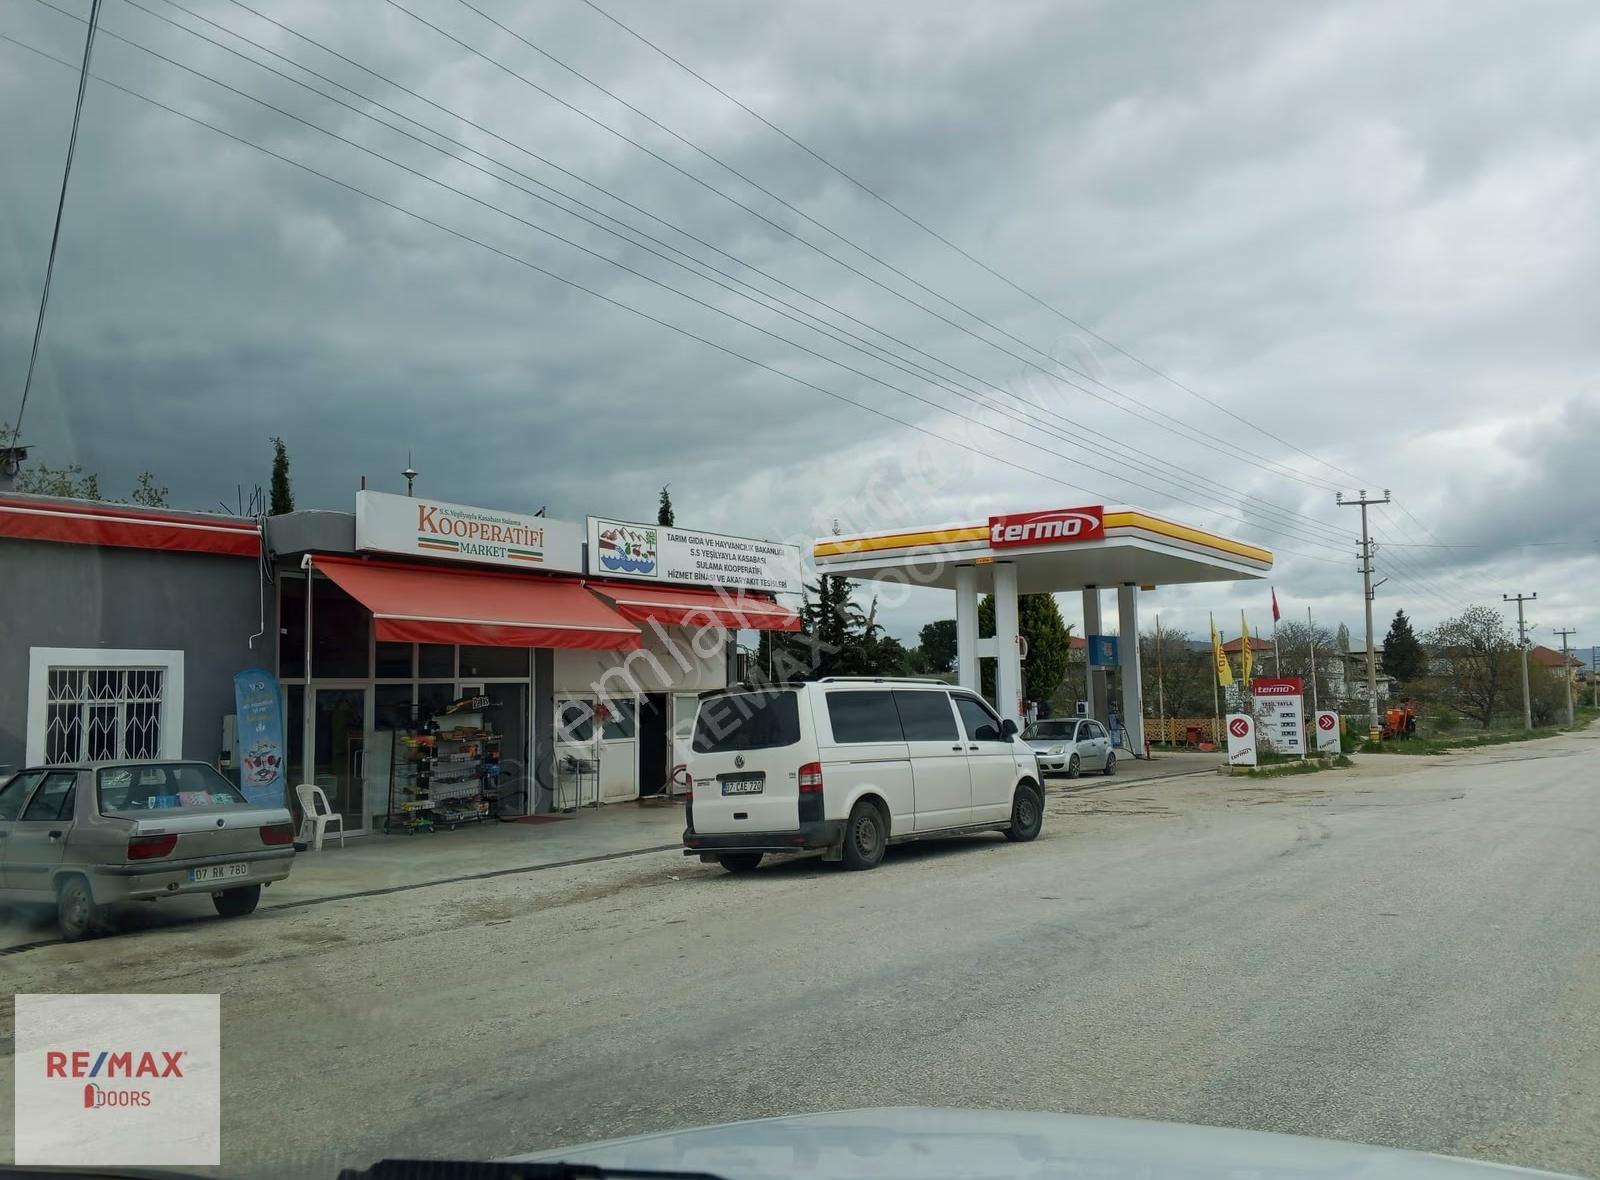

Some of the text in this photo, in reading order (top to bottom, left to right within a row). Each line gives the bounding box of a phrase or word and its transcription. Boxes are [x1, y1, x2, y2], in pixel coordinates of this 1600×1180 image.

[418, 504, 545, 548] KOOPERATİFİ
[991, 518, 1082, 543] termo
[667, 533, 688, 543] TARIM
[688, 535, 704, 546] GIDA
[705, 537, 714, 547] VE
[715, 538, 754, 552] HAYVANCILIK
[460, 542, 508, 558] MARKET
[696, 561, 723, 571] SULAMA
[667, 569, 693, 579] HİZMET
[716, 574, 726, 583] VE
[1257, 685, 1290, 693] termo
[736, 780, 748, 791] CAE
[750, 780, 762, 791] 720
[212, 867, 225, 878] RK
[229, 864, 247, 876] 780
